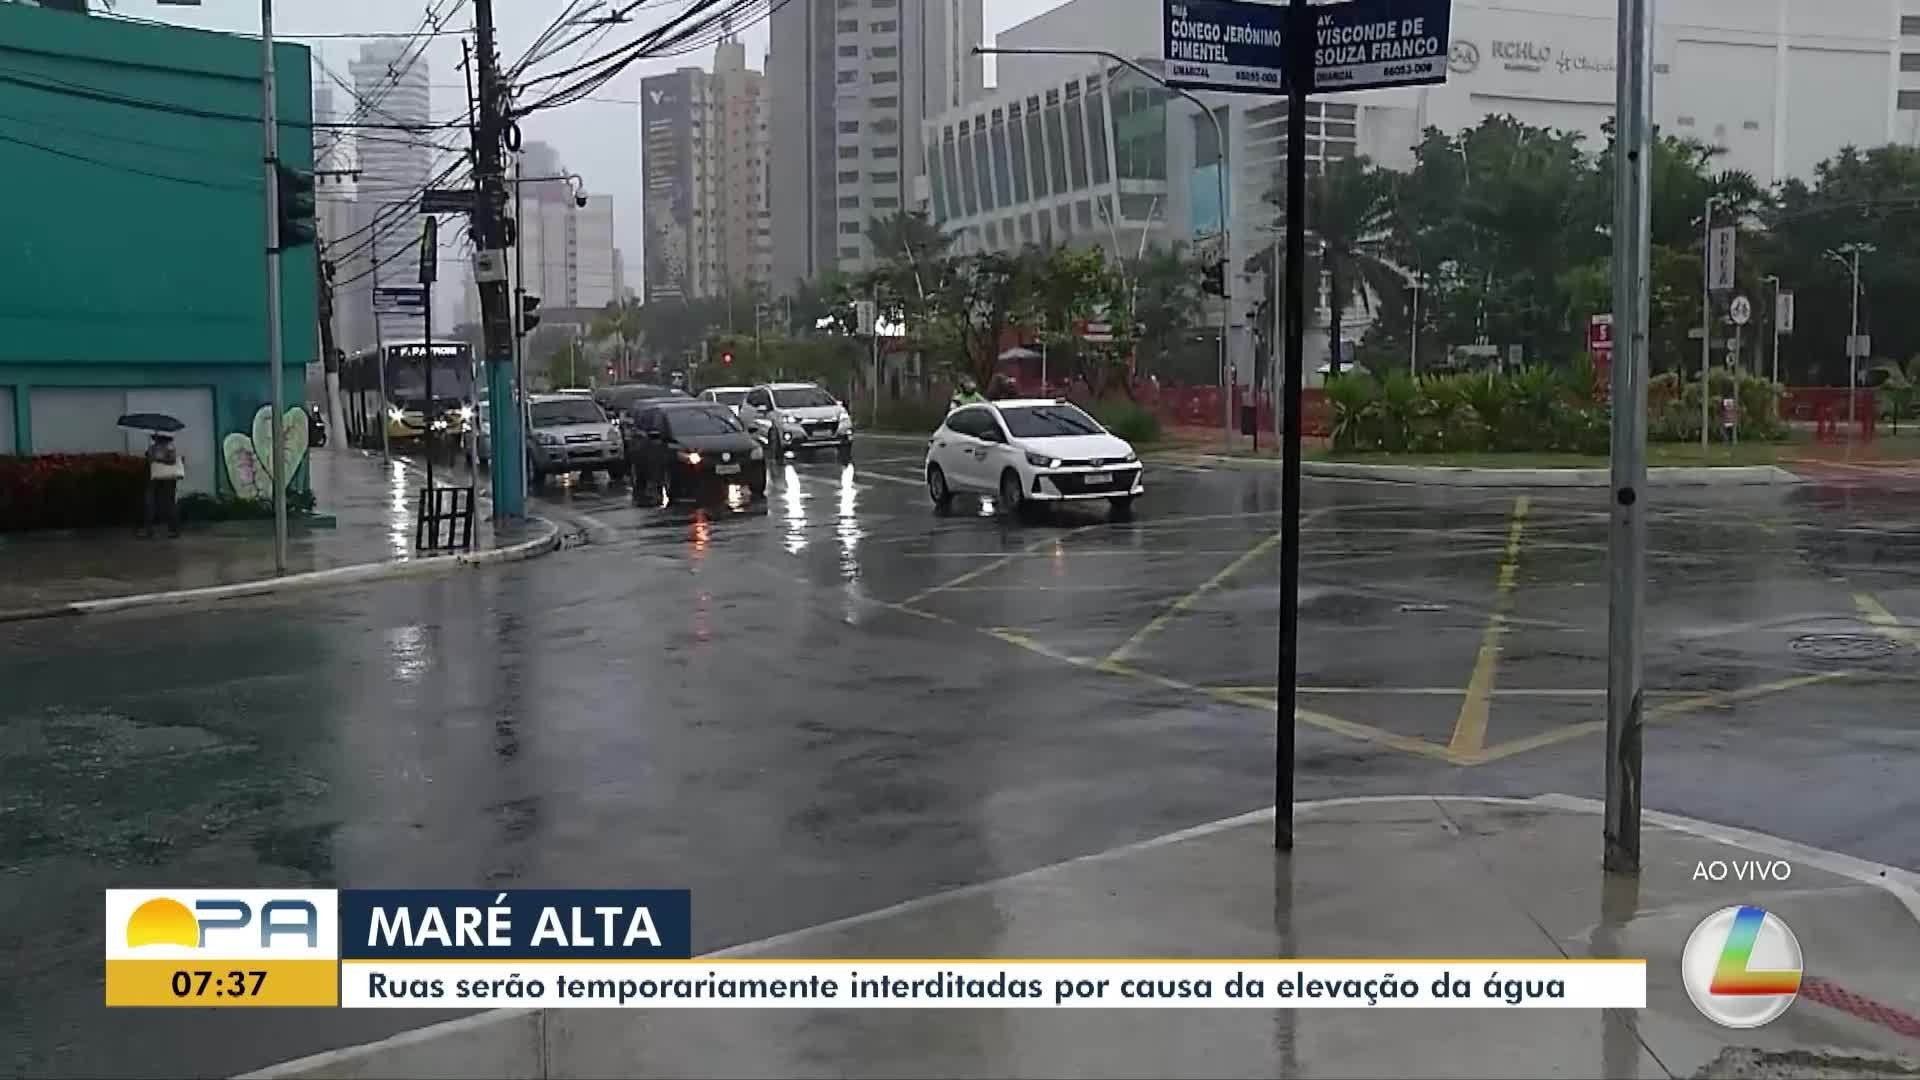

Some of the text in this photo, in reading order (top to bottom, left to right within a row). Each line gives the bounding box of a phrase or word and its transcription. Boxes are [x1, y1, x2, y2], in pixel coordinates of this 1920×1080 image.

[1317, 15, 1334, 26] AV.
[1317, 17, 1425, 46] VISCONDE DE
[1171, 39, 1228, 62] PIMENTEL
[1315, 36, 1438, 66] SOUZA FRANCO
